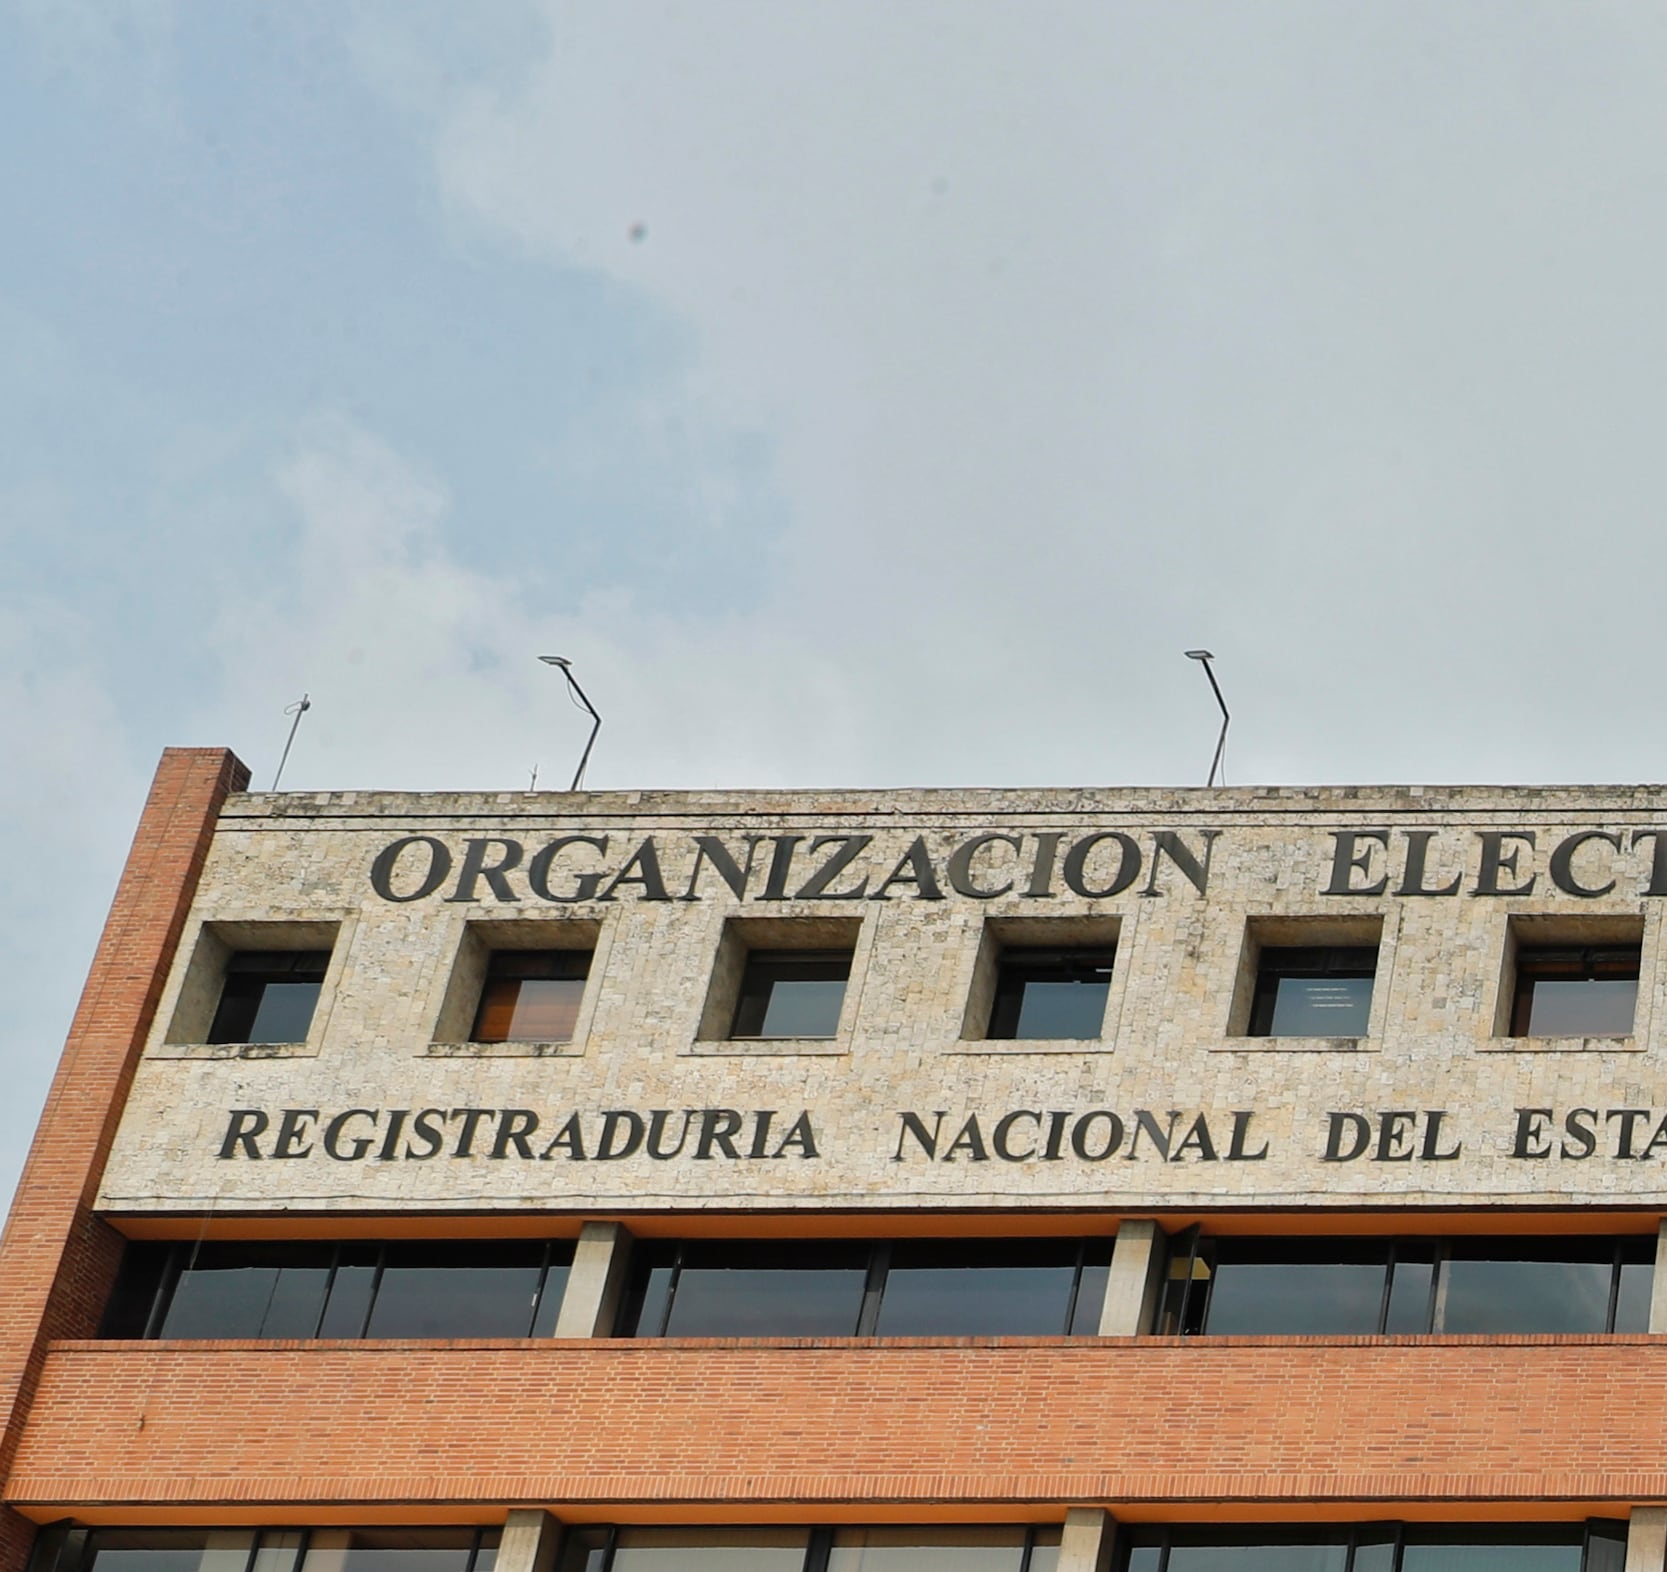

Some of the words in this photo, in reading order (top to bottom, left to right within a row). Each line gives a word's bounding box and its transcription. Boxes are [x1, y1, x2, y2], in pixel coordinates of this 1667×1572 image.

[370, 829, 1222, 904] ORGANIZACION
[217, 1107, 820, 1162] REGISTRADURIA
[890, 1108, 1270, 1163] NACIONAL
[1323, 1109, 1462, 1163] DEL
